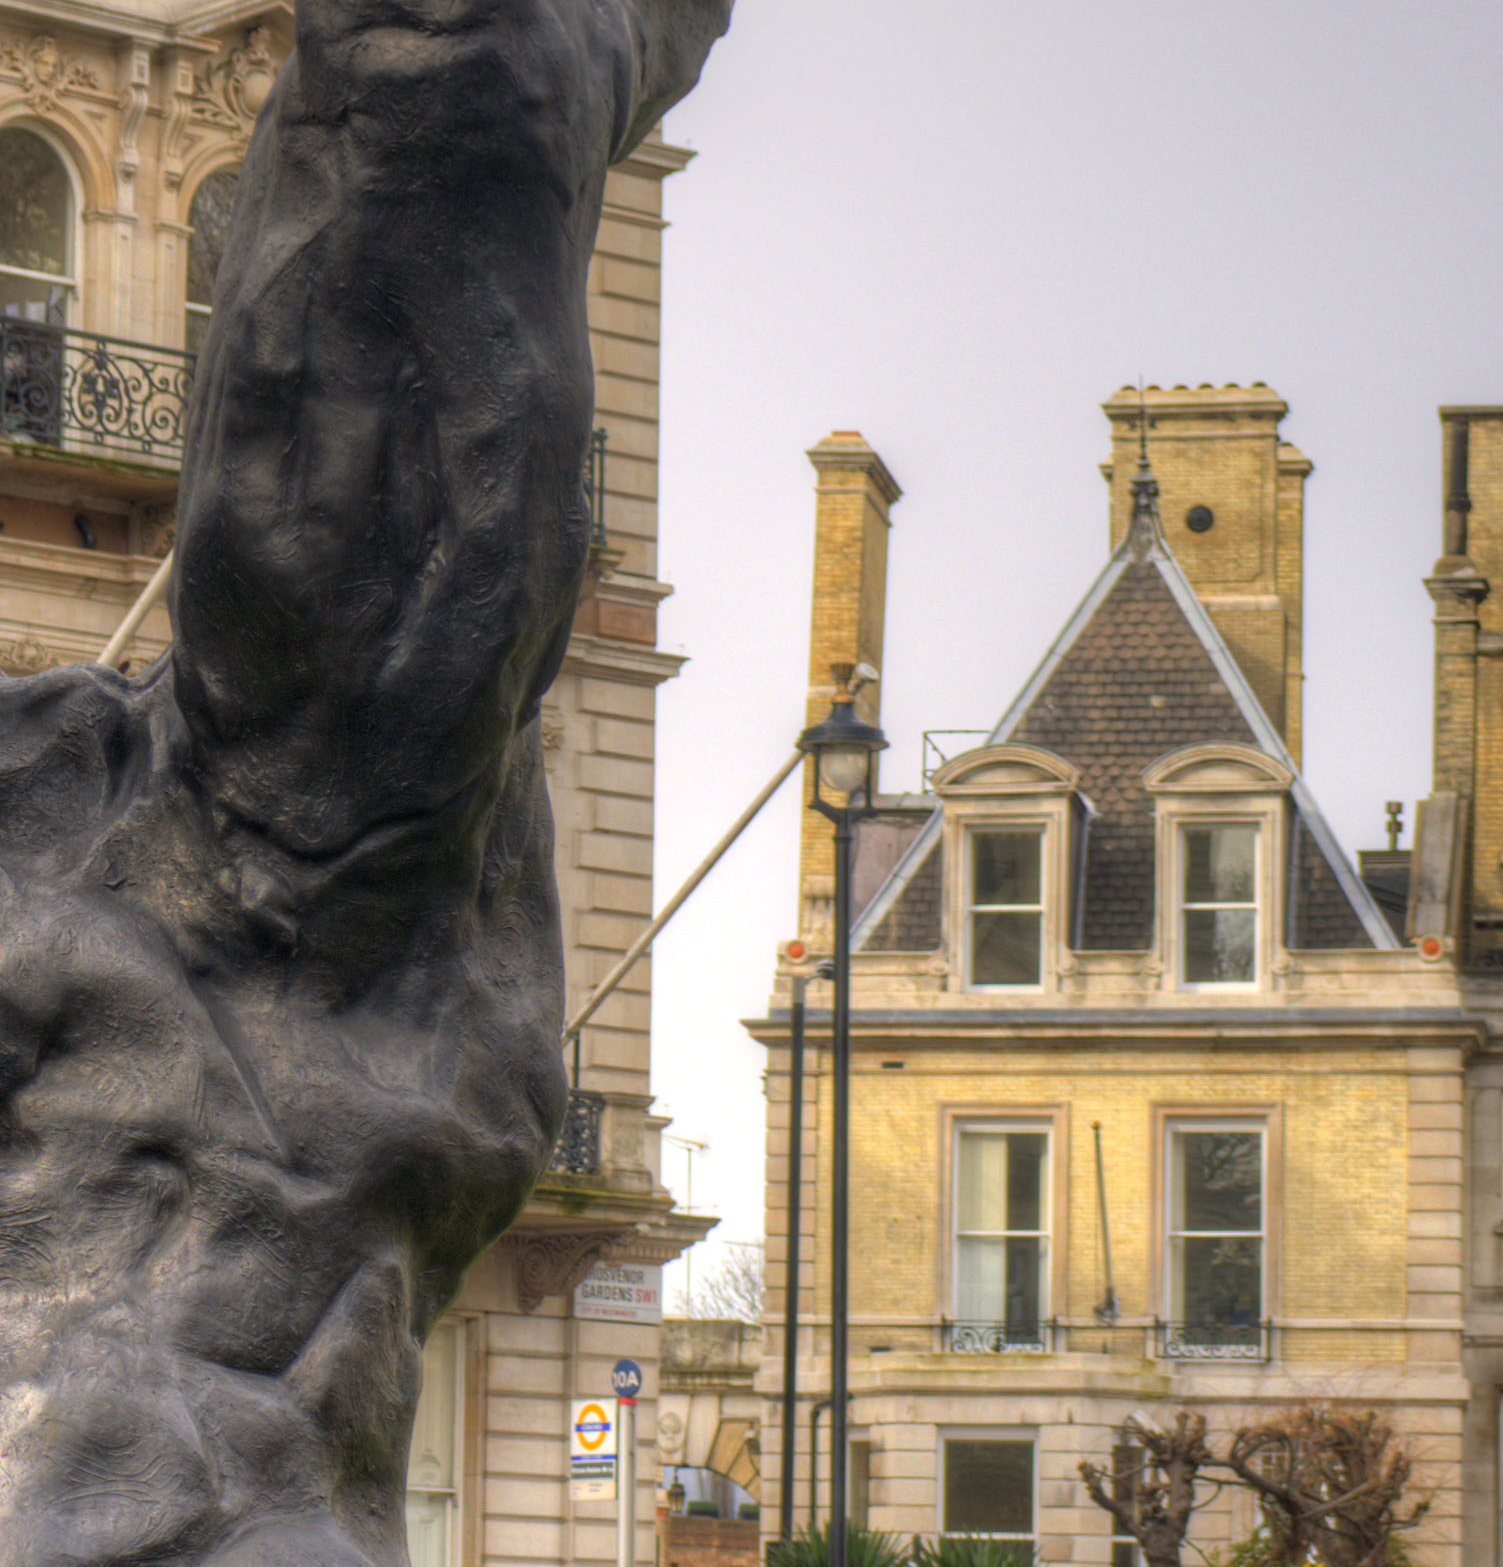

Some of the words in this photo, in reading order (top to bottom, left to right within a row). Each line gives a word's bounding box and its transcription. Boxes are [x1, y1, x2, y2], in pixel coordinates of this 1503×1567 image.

[581, 1283, 633, 1302] GARDENS
[635, 1287, 657, 1304] SW1
[612, 1370, 639, 1388] 10A
